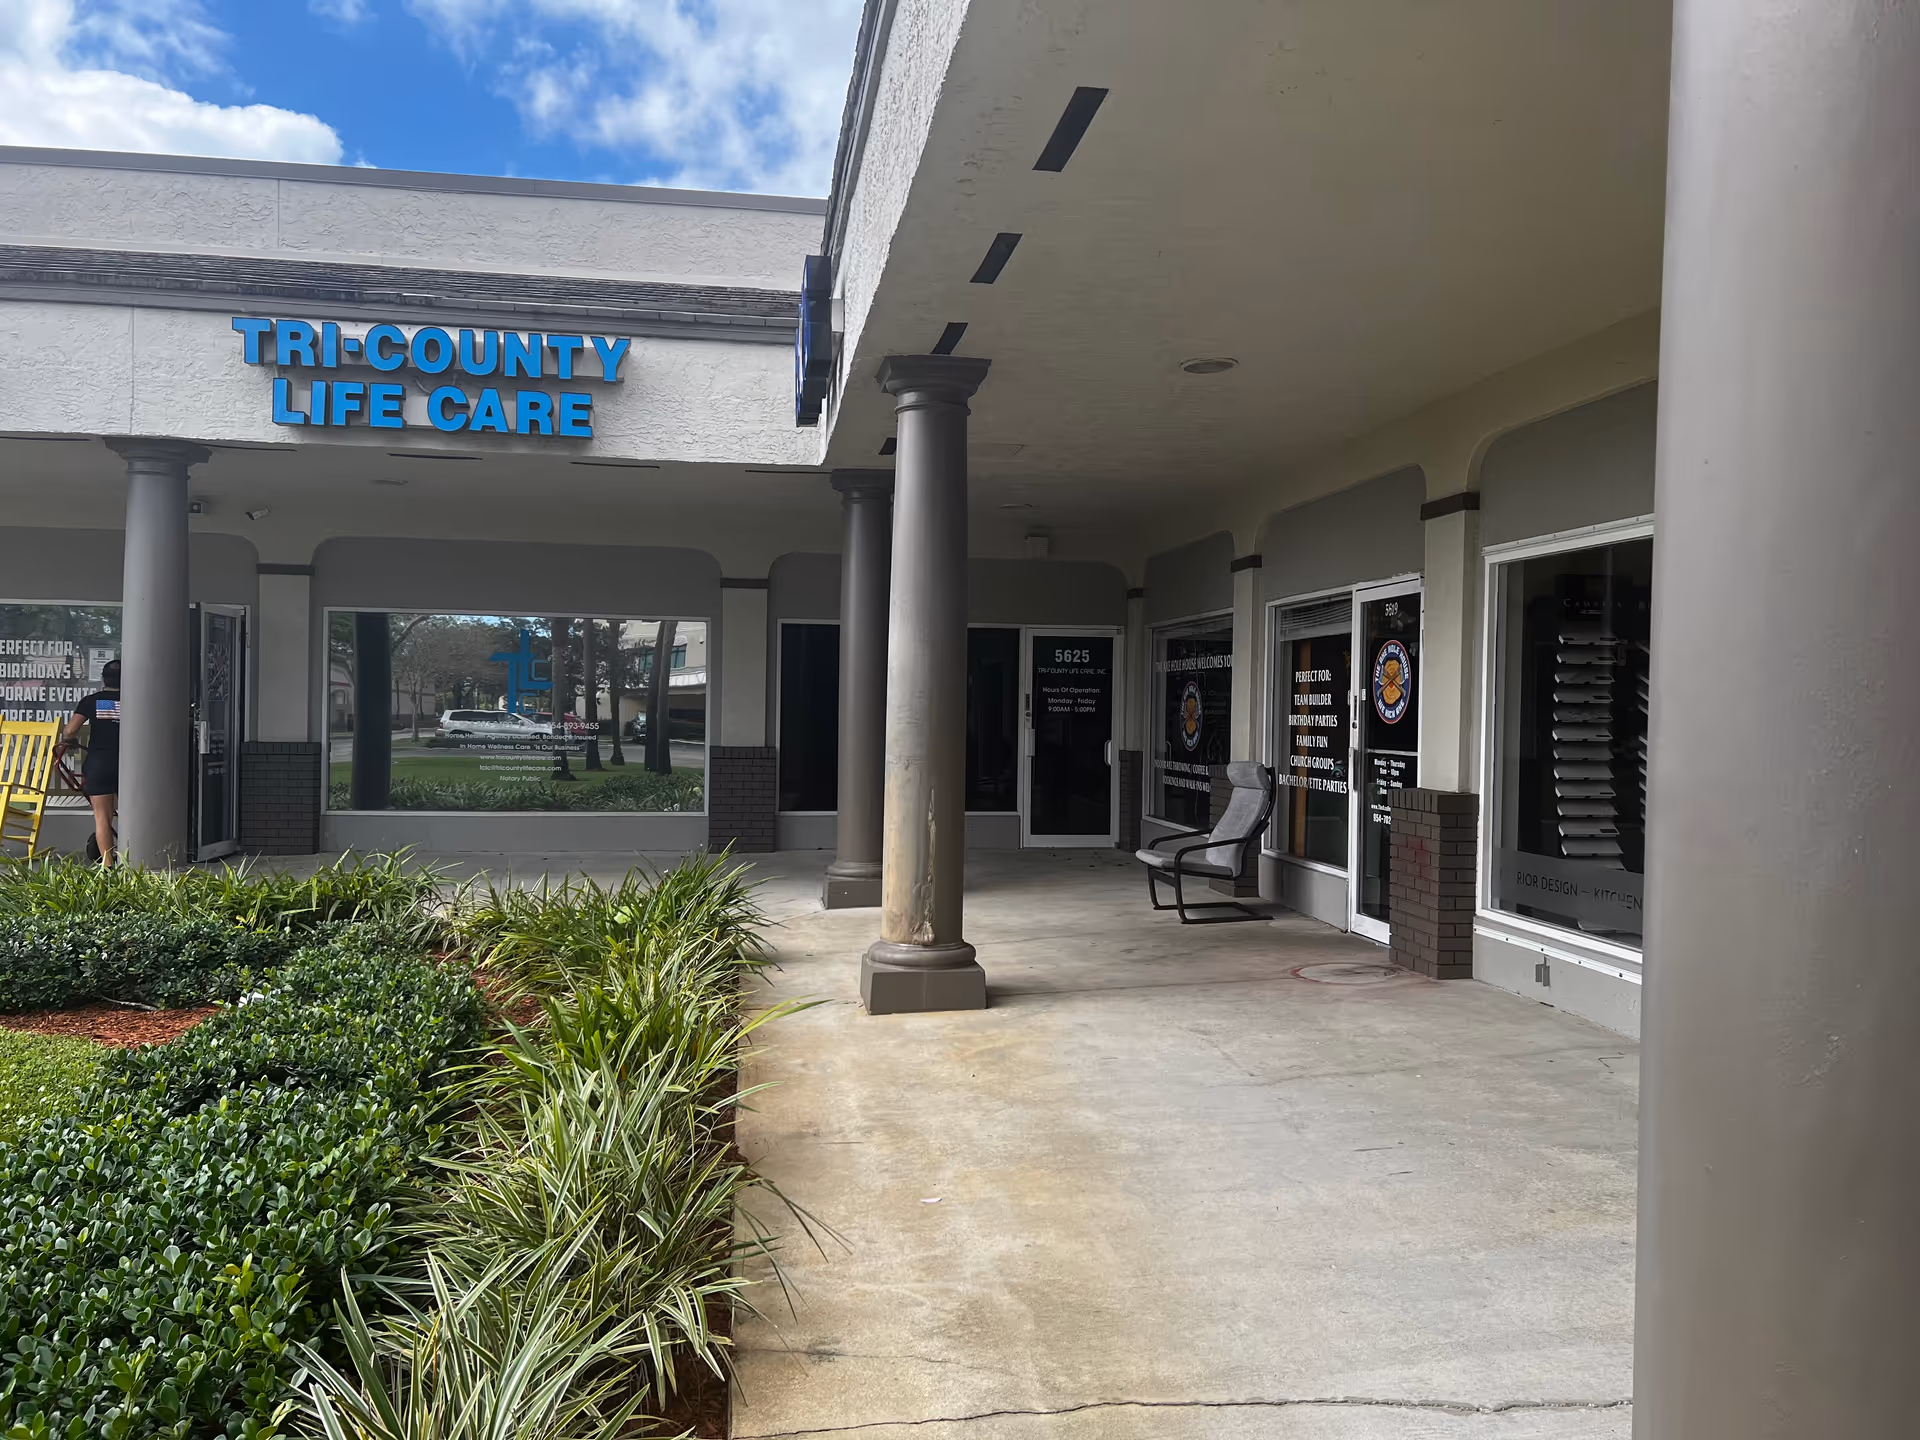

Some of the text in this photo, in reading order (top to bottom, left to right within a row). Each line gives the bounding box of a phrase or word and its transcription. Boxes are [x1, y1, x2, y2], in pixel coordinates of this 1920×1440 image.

[232, 316, 629, 382] TRI-COUNTY
[271, 377, 594, 438] LIFE CARE
[1055, 649, 1090, 663] 5625
[1197, 655, 1223, 670] WELCOMES
[0, 662, 71, 679] BIRTHDAYS
[1295, 670, 1317, 683] PERFECT
[1077, 697, 1096, 705] Friday
[1294, 693, 1332, 706] TEAM BUILDER
[1288, 714, 1338, 727] BIRTHDAY PARTIES
[488, 743, 514, 751] Wellness
[1316, 735, 1329, 748] FUN
[1290, 754, 1334, 770] CHURCH GROUPS
[1322, 779, 1347, 794] PARTIES
[1541, 876, 1578, 897] DESIGN
